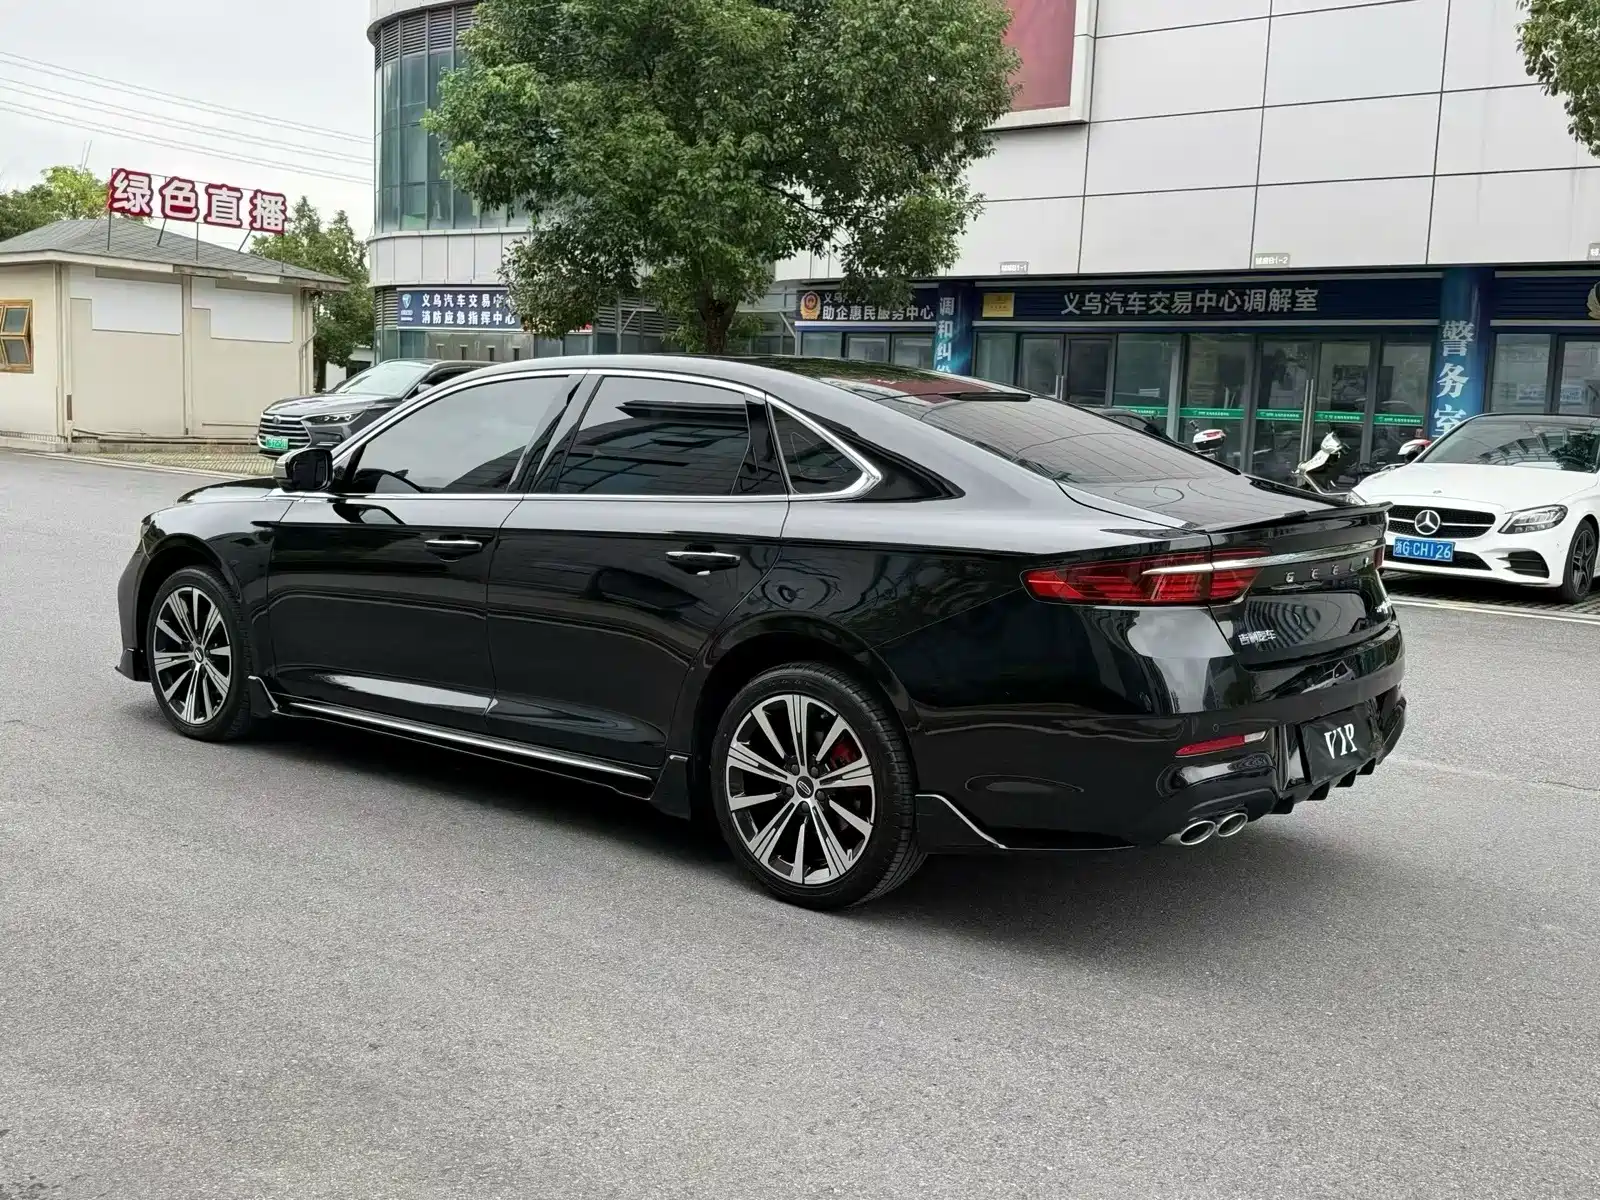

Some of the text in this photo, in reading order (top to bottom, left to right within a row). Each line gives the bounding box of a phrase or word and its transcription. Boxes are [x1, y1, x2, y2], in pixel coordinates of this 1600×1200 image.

[111, 170, 286, 232] 绿色直播
[822, 305, 935, 321] 助企惠民服务中心
[1060, 287, 1319, 315] 义乌汽车交易中心调解室
[421, 310, 516, 326] 消防应急指挥中心
[1432, 320, 1475, 438] 警务室
[1323, 723, 1358, 760] VIP
